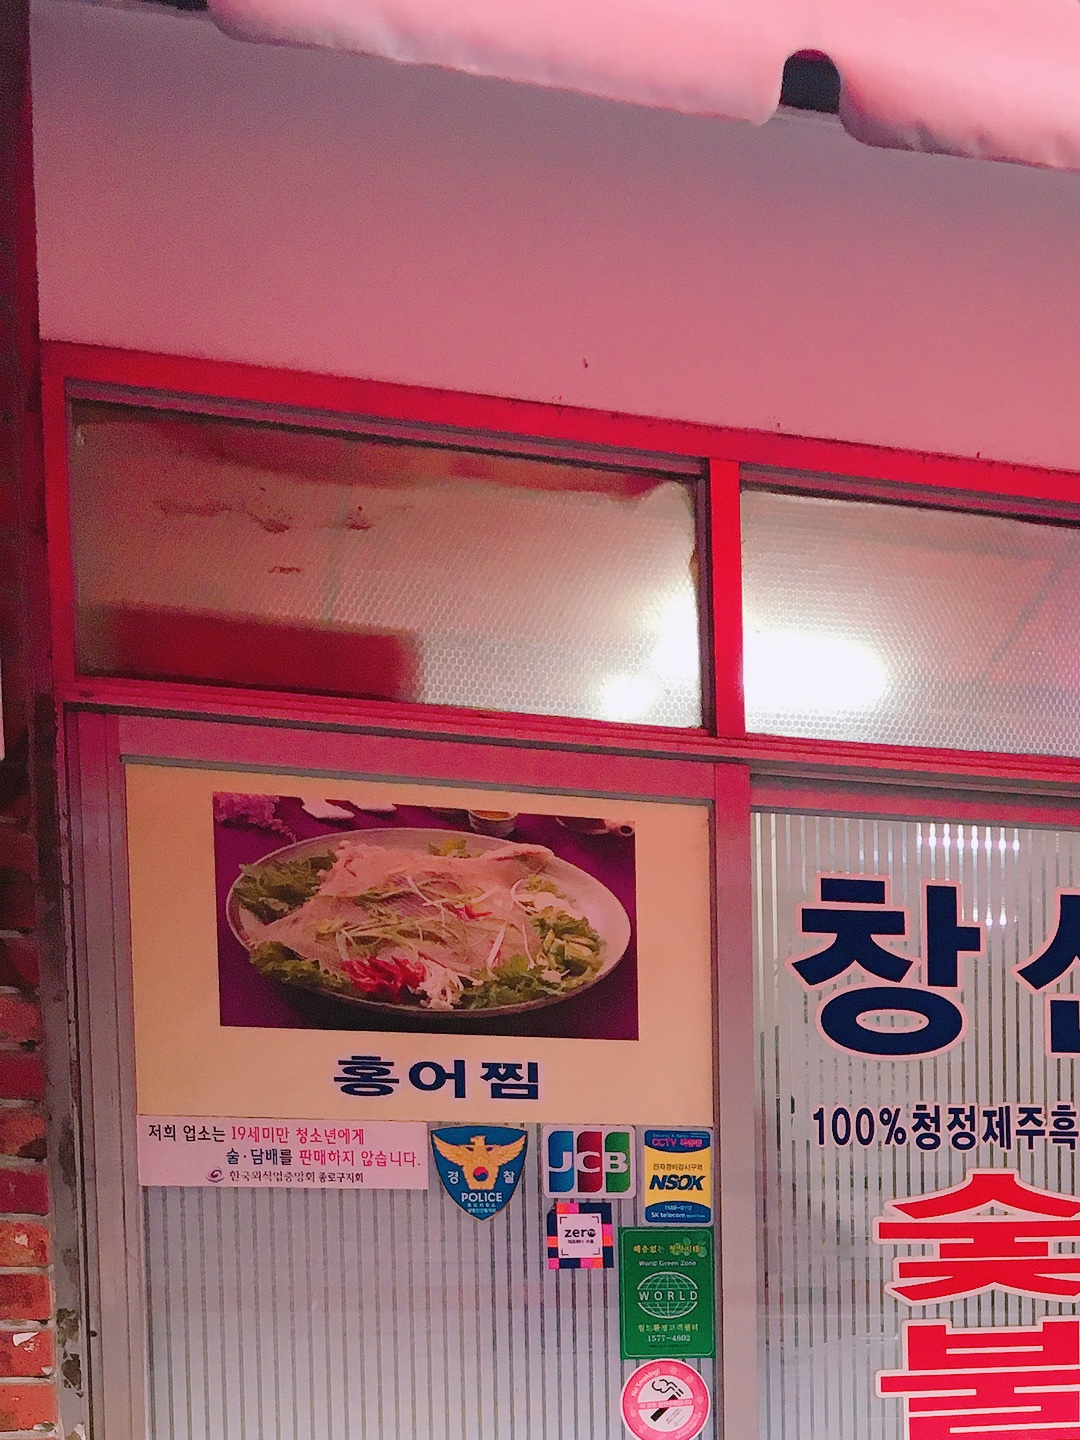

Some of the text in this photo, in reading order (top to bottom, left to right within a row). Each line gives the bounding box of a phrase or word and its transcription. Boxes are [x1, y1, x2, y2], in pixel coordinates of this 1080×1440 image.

[334, 1056, 539, 1100] 홍어찜
[149, 1124, 365, 1145] 저희 업소는 19세미만 청소년에게
[299, 1150, 355, 1167] 판매하지
[229, 1171, 364, 1183] 한국외식업중앙회 종로구지회
[447, 1171, 459, 1184] 경
[503, 1170, 515, 1184] 찰
[649, 1173, 706, 1191] NSOK
[461, 1192, 503, 1202] POLICE
[639, 1291, 698, 1301] WORLD
